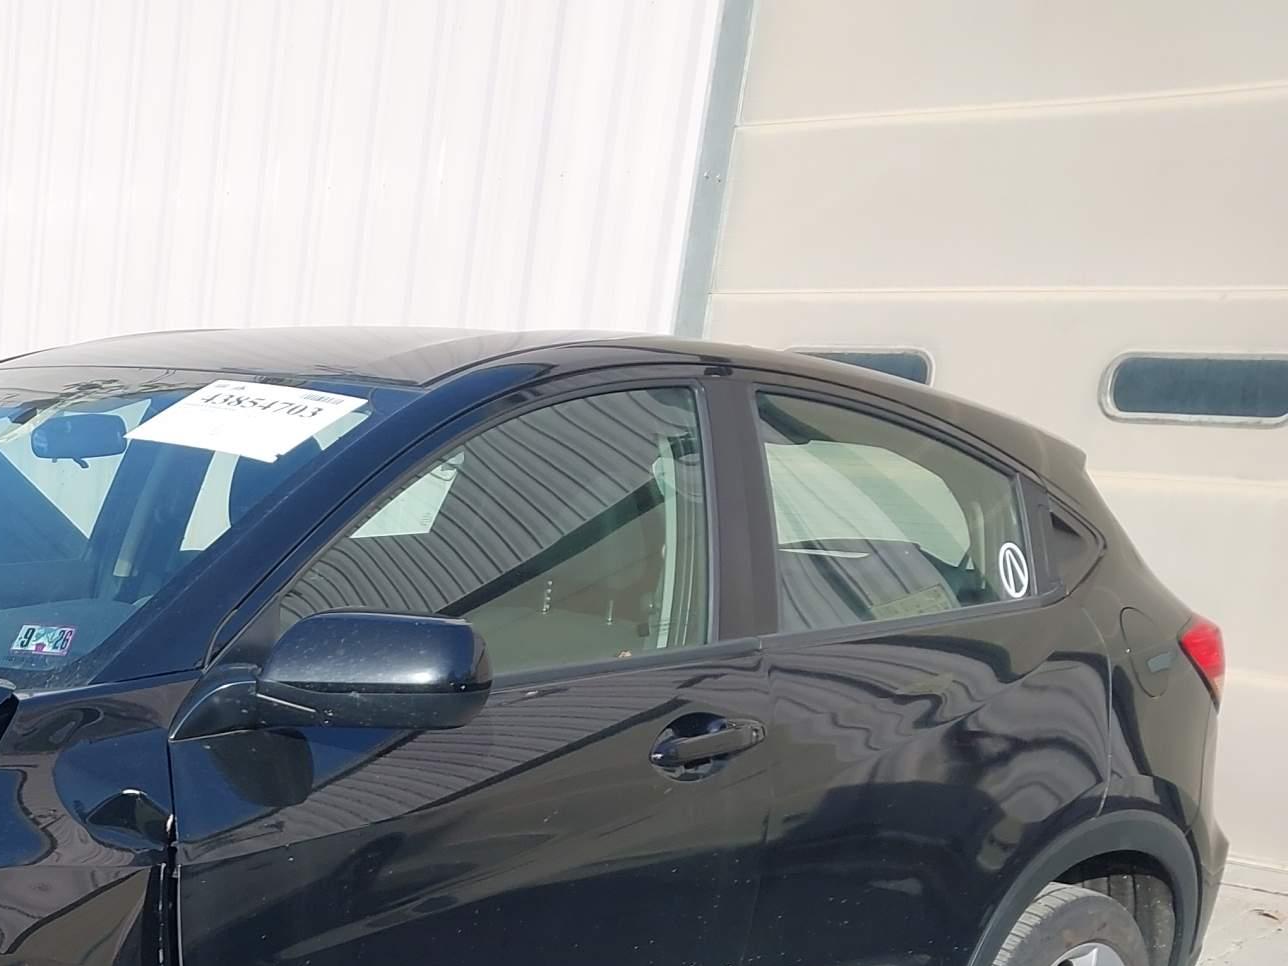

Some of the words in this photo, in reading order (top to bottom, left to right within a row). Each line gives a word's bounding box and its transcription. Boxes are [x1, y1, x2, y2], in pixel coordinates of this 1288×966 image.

[201, 392, 324, 418] 43854703
[19, 627, 36, 648] 9
[52, 629, 73, 650] 26
